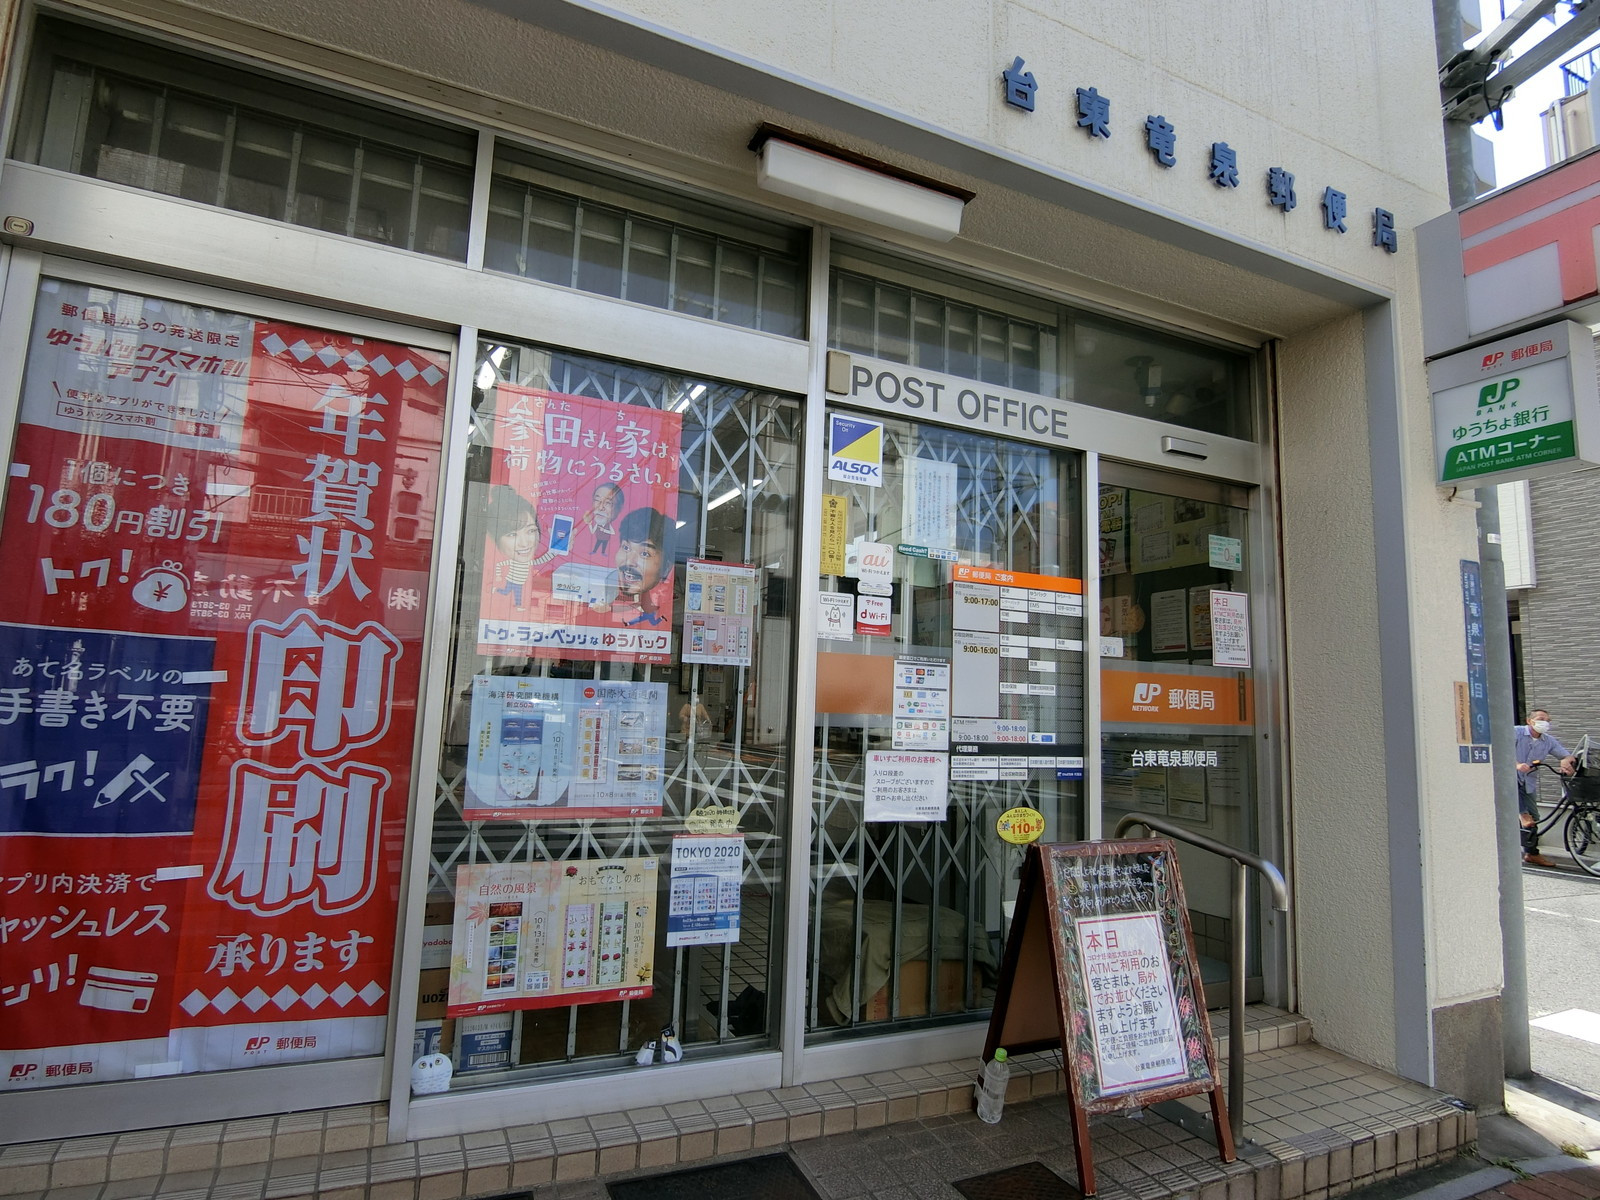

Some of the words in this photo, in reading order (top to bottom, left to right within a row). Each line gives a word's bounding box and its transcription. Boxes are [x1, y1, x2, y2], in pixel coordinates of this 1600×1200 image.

[1003, 55, 1397, 253] 台東竜泉郵便局
[61, 303, 240, 348] 郵便局からの発送限定
[46, 327, 248, 378] ゆうパックスマホ割
[1511, 340, 1553, 362] 郵便局
[107, 362, 177, 388] アプリ
[852, 365, 945, 413] POST
[957, 389, 1069, 440] OFFICE
[1478, 377, 1520, 408] JP
[66, 388, 217, 421] 便利なアプリができました!
[535, 396, 571, 412] さんた
[1476, 401, 1517, 416] BANK
[64, 406, 156, 427] ゆうパックスマホ割
[616, 410, 626, 421] ち
[835, 420, 856, 429] Security
[1453, 404, 1550, 441] ゆうちょ銀行
[1455, 434, 1561, 465] ATMコーナー
[1456, 463, 1476, 473] JAPAN
[1477, 460, 1494, 469] POST
[1495, 456, 1515, 465] BANK
[1516, 452, 1533, 461] ATM
[1533, 446, 1562, 458] CORNER
[66, 459, 191, 496] 1個につき
[503, 445, 672, 489] 荷物にうるさい。
[832, 460, 879, 477] ALSOK
[292, 382, 389, 602] 年賀状
[27, 483, 224, 544] 180円割引
[863, 554, 889, 567] au
[41, 549, 134, 595] トク!
[972, 570, 992, 580] 郵便局
[995, 573, 1014, 583] ご案内
[963, 596, 999, 606] 9:00-17:00
[1213, 597, 1228, 607] 本日
[860, 609, 868, 619] d
[869, 612, 888, 621] Wi-Fi
[963, 645, 998, 655] 9:00-16:00
[12, 655, 183, 685] あて名ラベルの
[488, 690, 559, 700] 海洋研究開発機構
[597, 687, 658, 701] 国際文通週間
[1133, 682, 1162, 704] JP
[1168, 688, 1215, 711] 郵便局
[0, 686, 197, 732] 手書き不要
[1131, 704, 1159, 713] NETWORK
[958, 734, 989, 742] 9:00-18:00
[996, 724, 1027, 732] 9:00-18:00
[208, 610, 403, 916] 印刷
[873, 755, 942, 764] 車いすご利用のお客様へ
[1131, 748, 1218, 768] 台東竜泉郵便局
[1474, 750, 1487, 760] 9-6
[876, 778, 935, 786] スロープがございますので
[676, 847, 712, 859] TOKYO
[714, 845, 740, 857] 2020
[0, 871, 157, 895] プリ内決済で
[479, 882, 537, 896] 自然の風景
[578, 873, 642, 886] おもてなしの花
[1086, 930, 1119, 952] 本日
[204, 930, 374, 978] 承ります
[1089, 955, 1160, 975] ATMご利用のお
[1091, 970, 1157, 991] 客さまは、局外
[1094, 984, 1168, 1005] でお並びください
[1096, 1000, 1163, 1021] ますようお願い
[1099, 1015, 1157, 1036] 申し上げます
[276, 1036, 317, 1050] 郵便局
[45, 1061, 93, 1078] 郵便局
